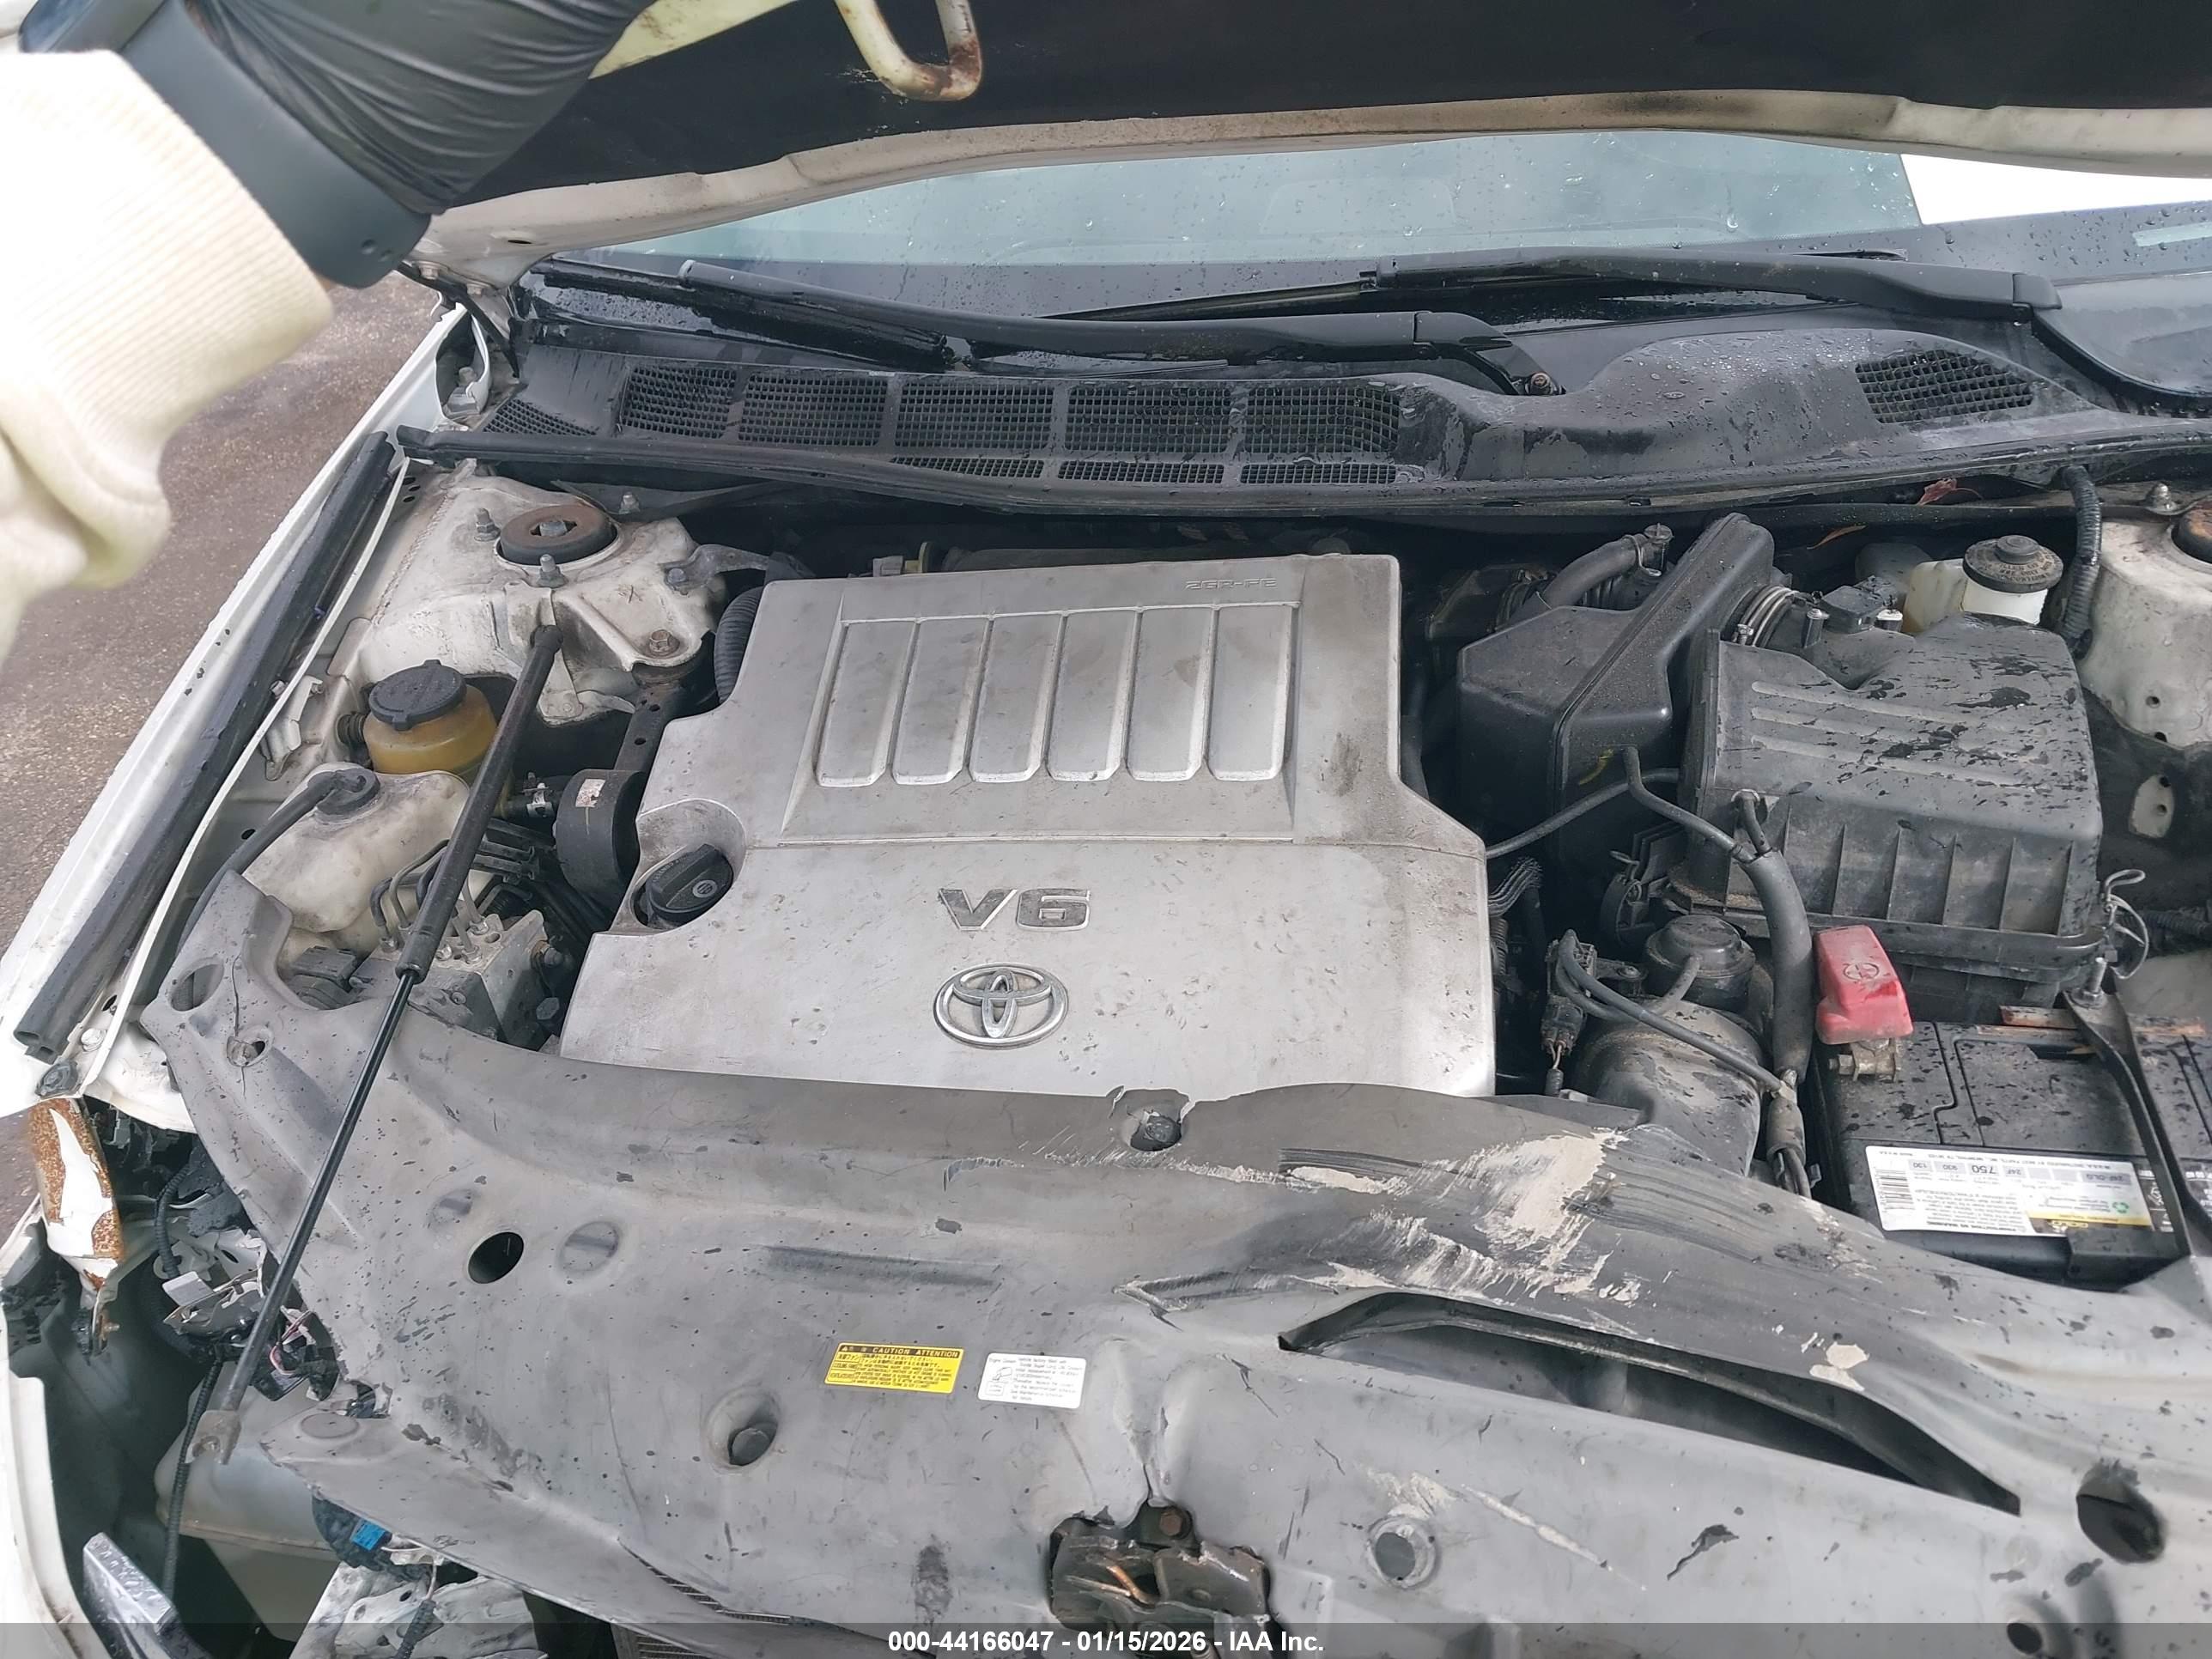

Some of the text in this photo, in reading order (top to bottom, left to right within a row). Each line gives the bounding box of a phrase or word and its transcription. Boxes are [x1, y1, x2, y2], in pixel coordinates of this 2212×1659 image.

[1184, 578, 1278, 591] 2GR-FE
[938, 888, 1091, 932] V6
[1971, 1164, 1997, 1175] 750
[915, 1349, 959, 1358] ATTENTION
